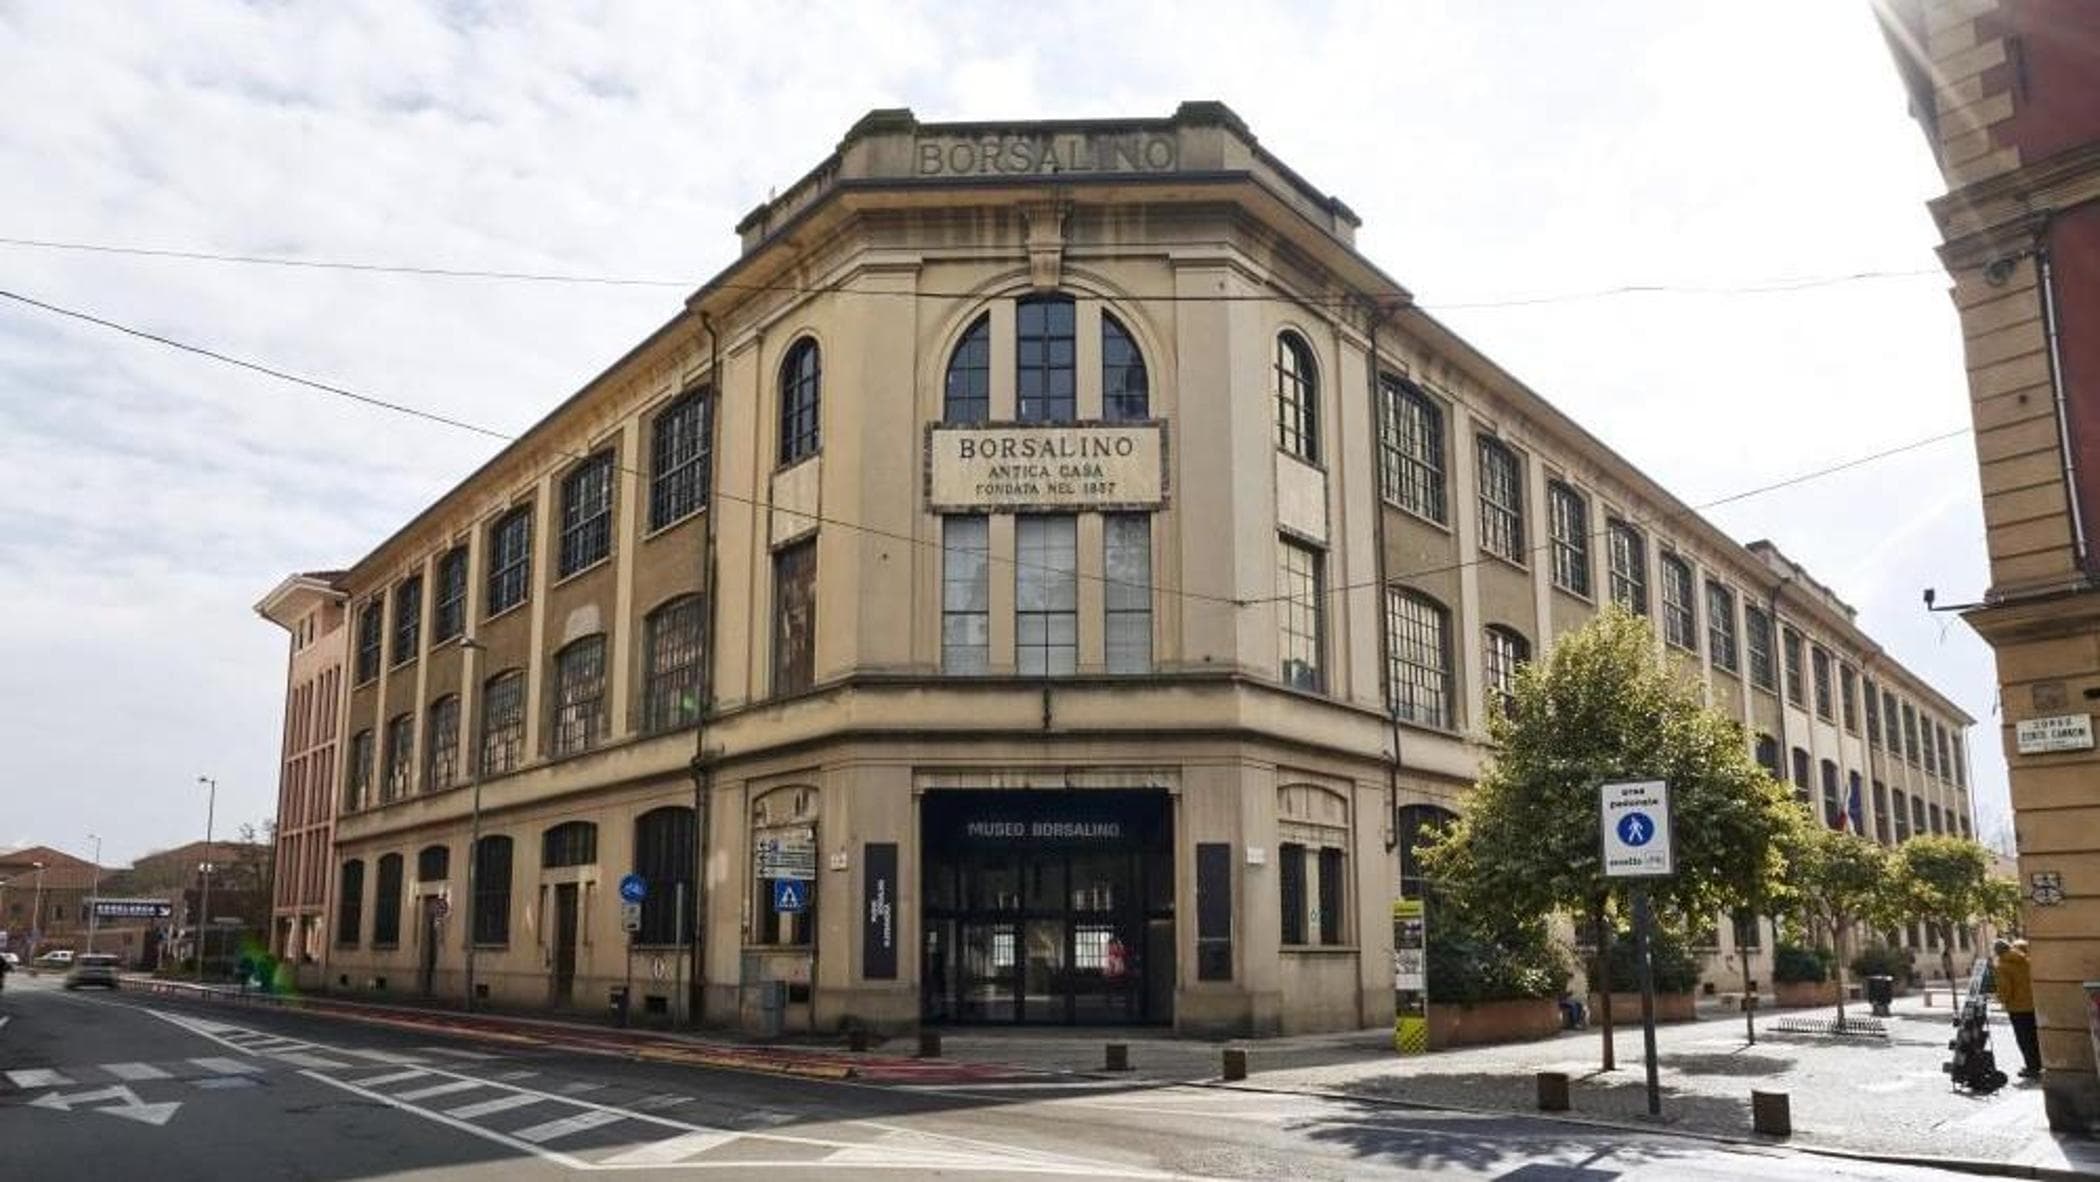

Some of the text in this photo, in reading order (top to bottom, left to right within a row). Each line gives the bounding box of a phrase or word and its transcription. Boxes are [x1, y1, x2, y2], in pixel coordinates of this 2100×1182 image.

[919, 137, 1175, 174] BORSALINO
[960, 436, 1133, 459] BORSALINO
[988, 464, 1104, 478] ANTICA CASA
[976, 483, 1040, 495] FONDATA
[1047, 483, 1075, 494] NEL
[967, 822, 1121, 837] MUSEO BORSALINO
